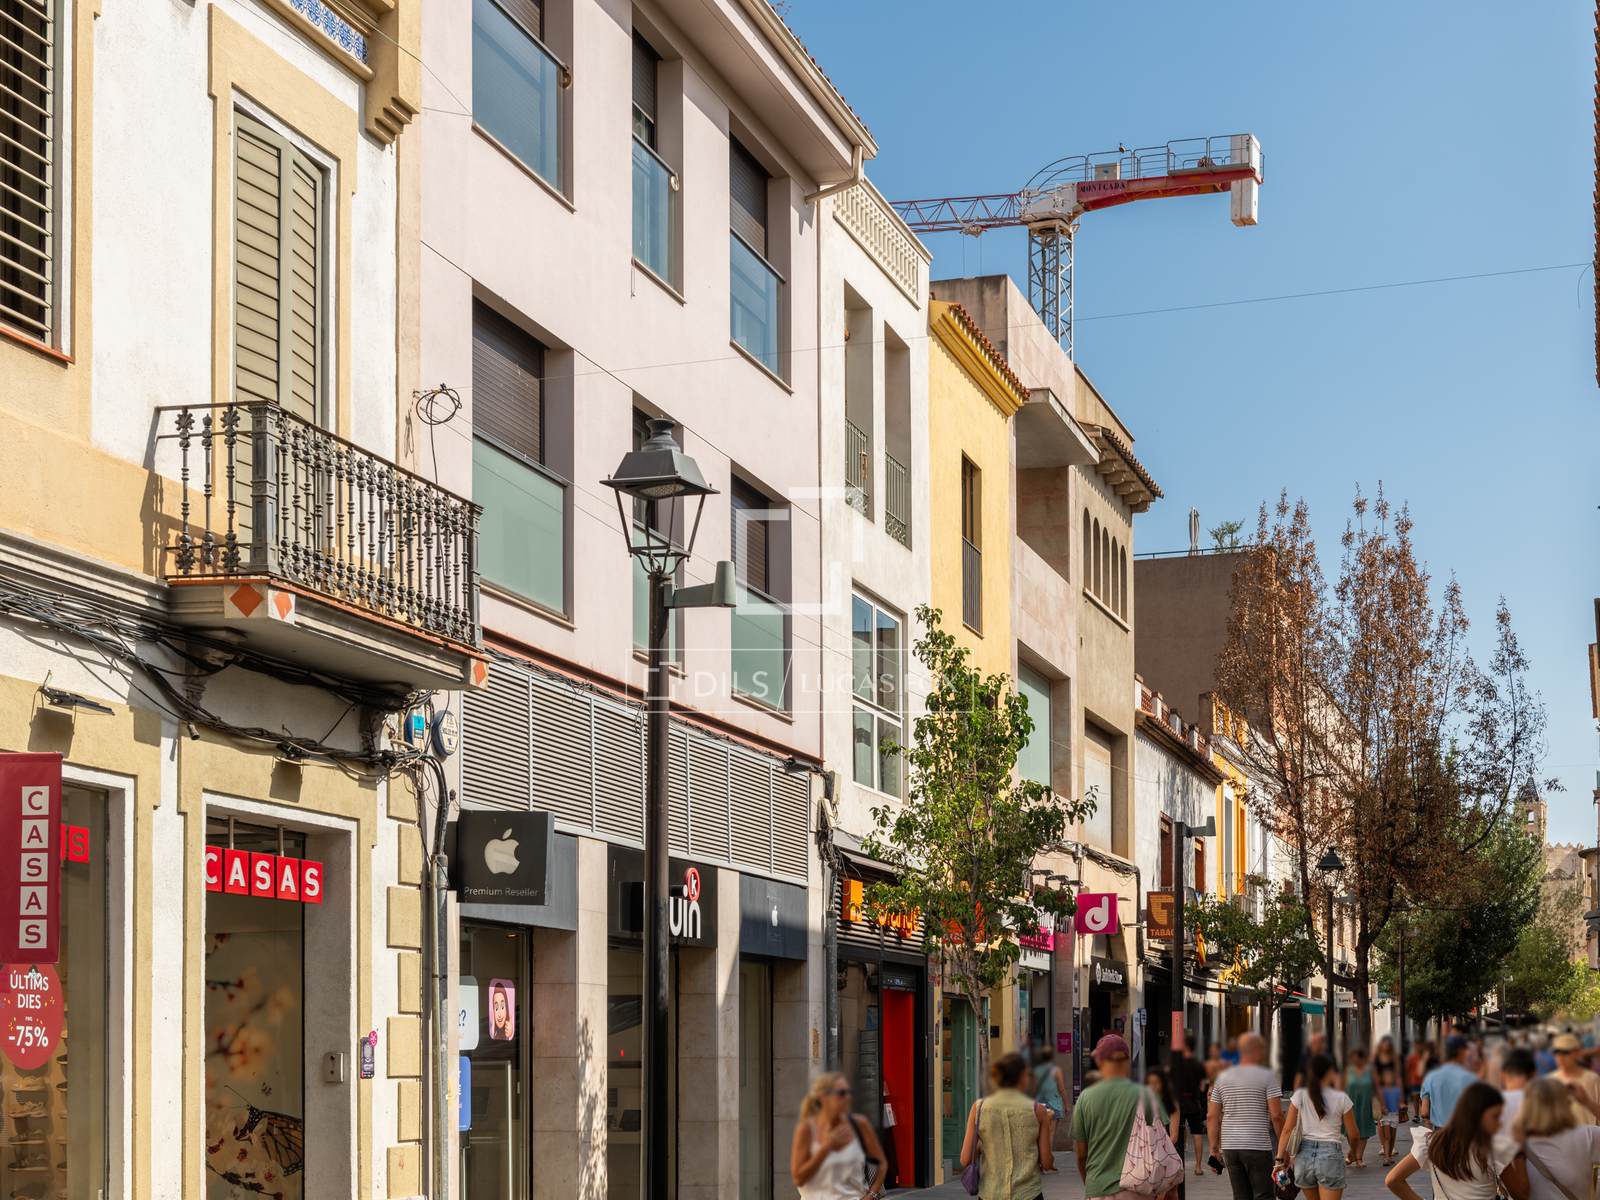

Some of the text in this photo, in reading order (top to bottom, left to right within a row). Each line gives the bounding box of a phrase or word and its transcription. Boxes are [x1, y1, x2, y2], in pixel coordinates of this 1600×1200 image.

[24, 790, 44, 945] CASAS
[205, 851, 320, 897] CASAS
[464, 886, 539, 897] Premium Reseller
[9, 969, 49, 992] ÚLTIMS
[17, 993, 42, 1010] DIES
[8, 1025, 49, 1048] -75%
